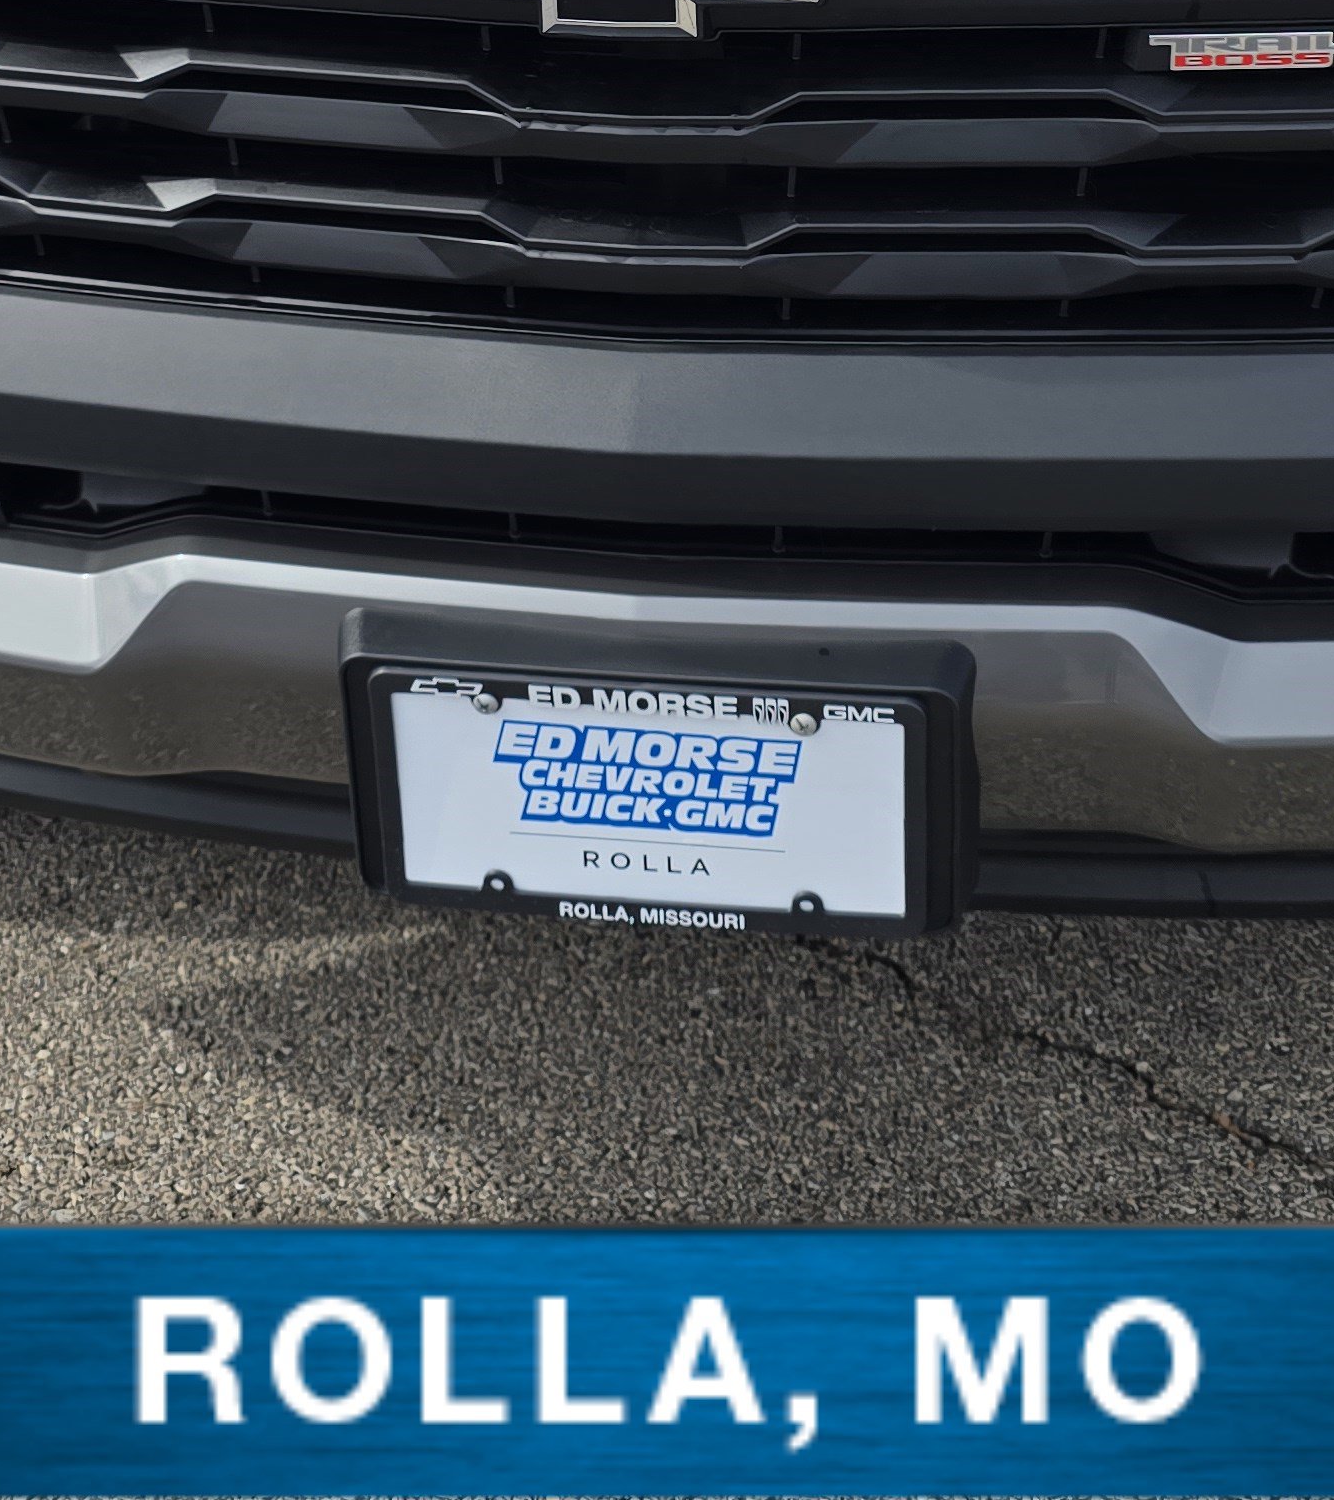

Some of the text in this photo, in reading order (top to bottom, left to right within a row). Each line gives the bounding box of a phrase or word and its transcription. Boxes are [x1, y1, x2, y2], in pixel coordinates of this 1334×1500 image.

[1173, 52, 1331, 68] BOSS
[528, 684, 895, 724] ED MORSE GMC
[497, 721, 799, 776] ED MORSE
[521, 758, 776, 802] CHEVROLET
[583, 850, 710, 877] ROLLA
[559, 901, 746, 931] ROLLA, MISSOURI
